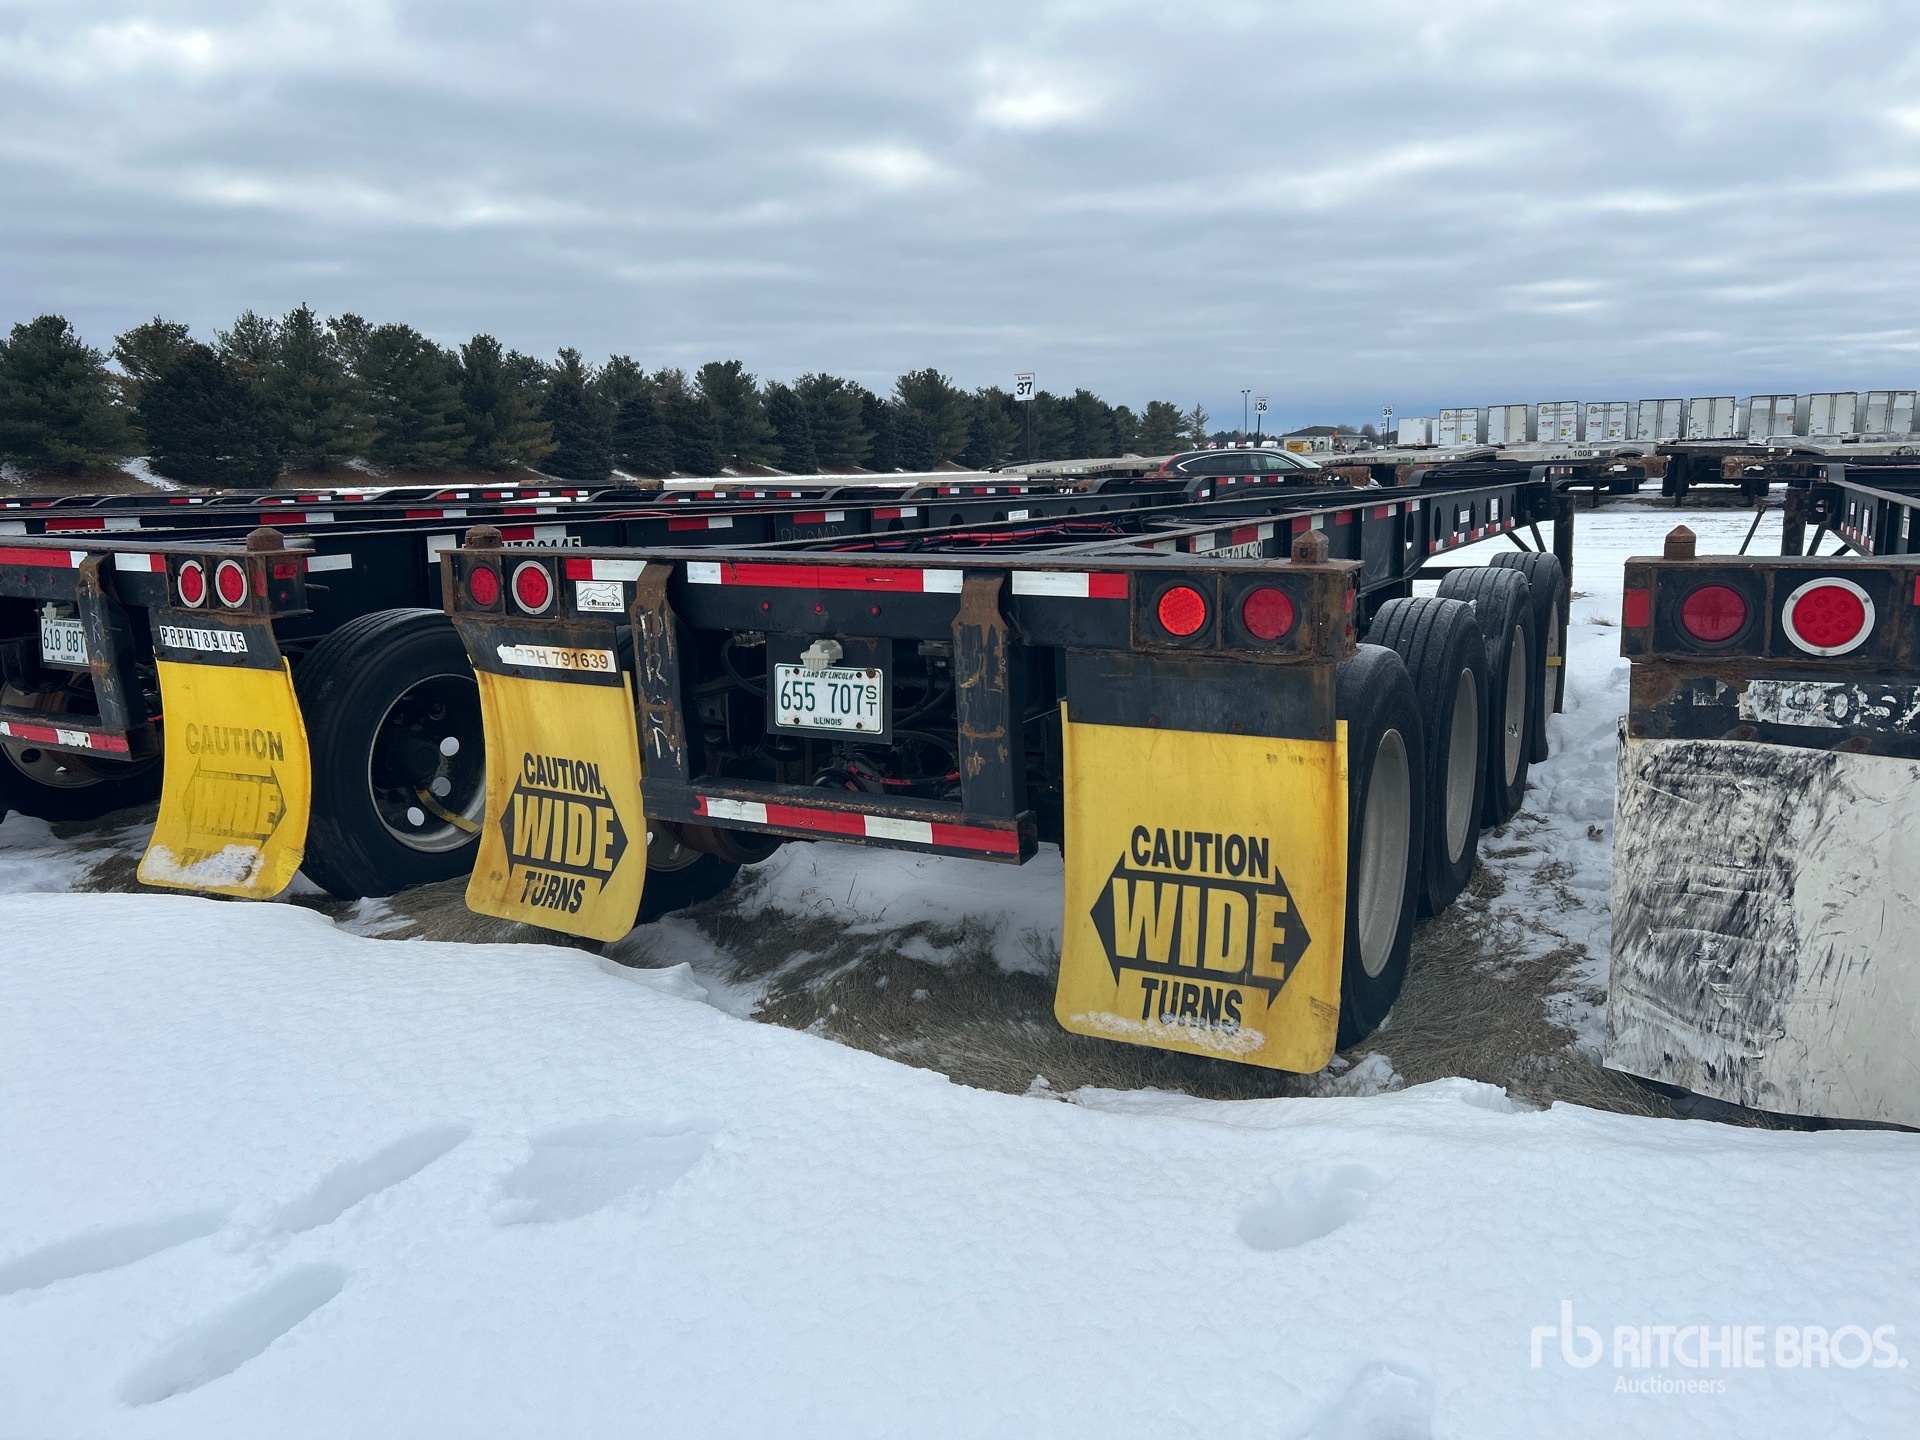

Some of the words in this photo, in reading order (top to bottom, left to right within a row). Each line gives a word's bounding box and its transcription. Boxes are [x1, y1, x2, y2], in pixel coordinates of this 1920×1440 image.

[1017, 382, 1033, 395] 37
[1258, 402, 1268, 411] 36
[1383, 408, 1393, 416] 35
[1573, 450, 1592, 458] 1008
[43, 627, 61, 651] 618
[66, 630, 84, 654] 887
[161, 627, 246, 651] PRPH789445
[551, 651, 609, 669] 791639
[802, 671, 819, 679] LAND
[781, 681, 816, 712] 655
[828, 683, 864, 715] 707
[813, 717, 842, 725] ILLINOIS
[186, 722, 285, 761] CAUTION
[523, 752, 602, 795] CAUTION
[194, 776, 279, 835] WIDE
[512, 793, 614, 872] WIDE
[1131, 825, 1269, 878] CAUTION
[519, 870, 586, 914] TURNS
[1112, 877, 1288, 980] WIDE
[1141, 977, 1242, 1034] TURNS
